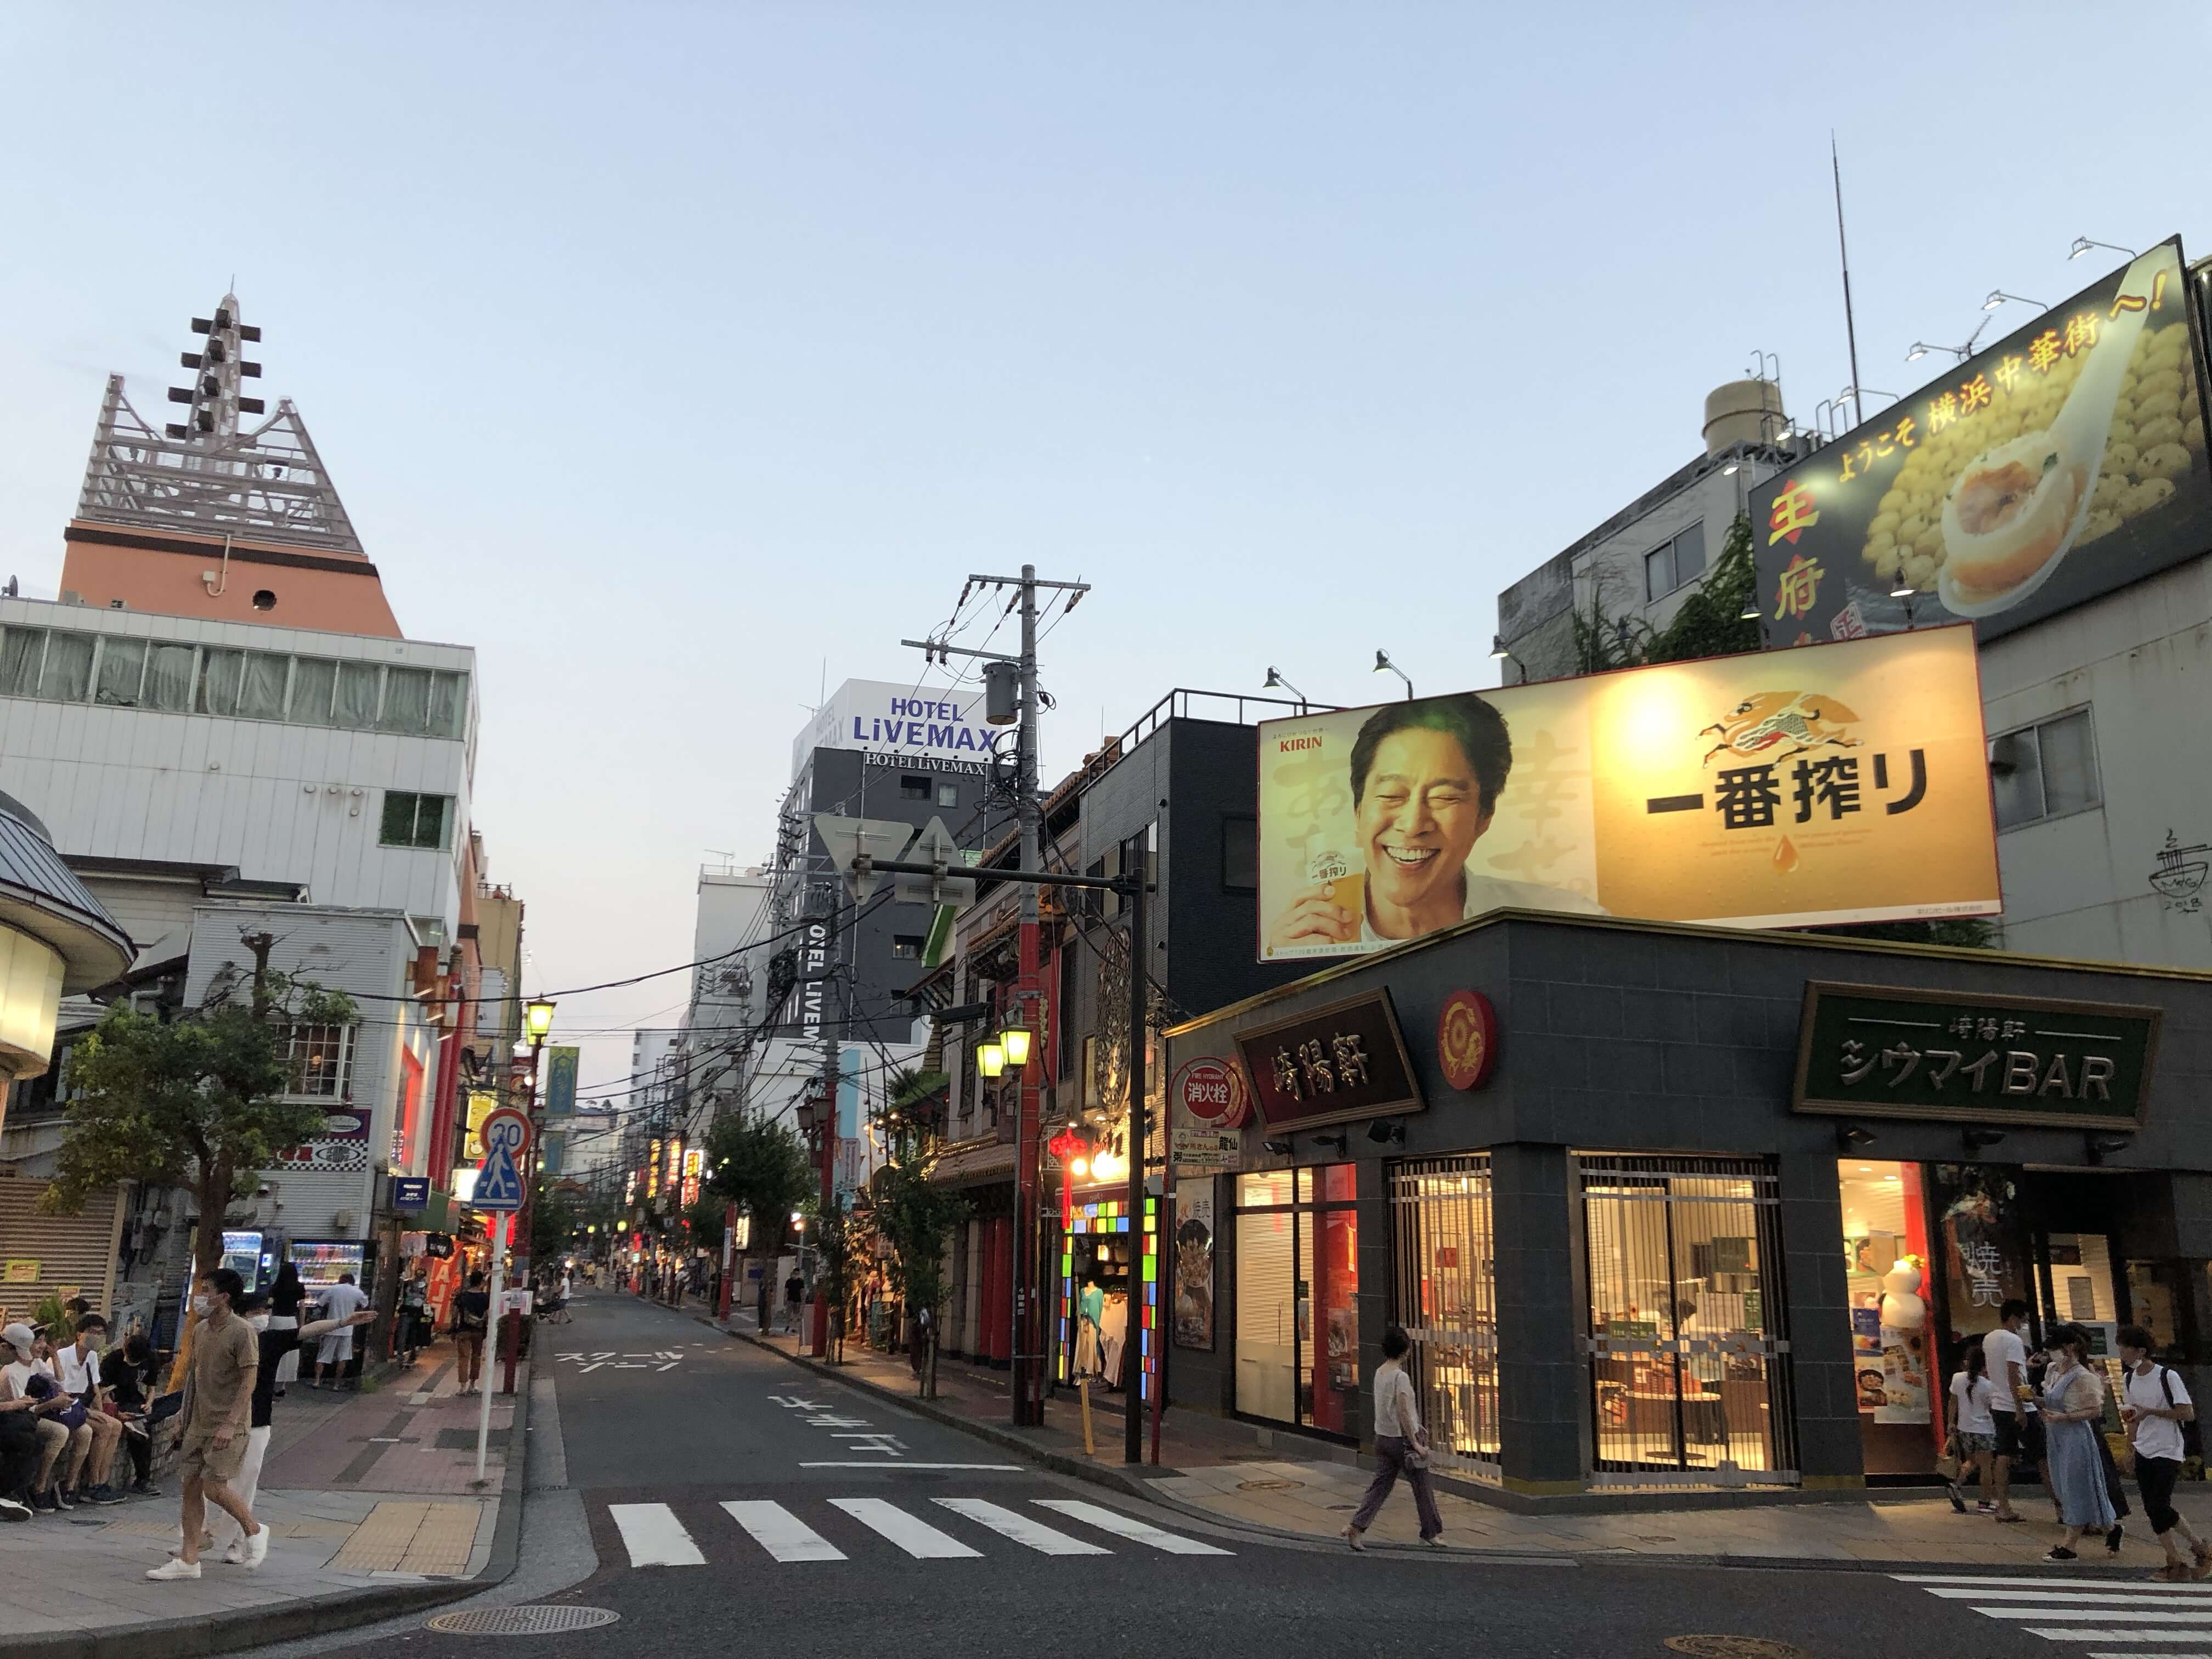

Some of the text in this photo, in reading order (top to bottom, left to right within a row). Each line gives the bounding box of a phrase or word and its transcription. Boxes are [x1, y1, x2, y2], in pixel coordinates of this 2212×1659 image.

[1839, 415, 1916, 483] ようこそ
[1768, 483, 1826, 646] 王府
[891, 697, 964, 722] HOTEL
[854, 716, 997, 753] LiVEMAX
[1280, 736, 1323, 753] KIRIN
[865, 752, 986, 776] HOTEL LiVEMAX
[1647, 749, 1928, 830] 一番搾り
[1312, 866, 1347, 879] 一番搾り
[1948, 1014, 2027, 1041] 崎陽軒
[1840, 1040, 2115, 1101] シウマイBAR
[1188, 1082, 1228, 1104] 消火栓
[1218, 1136, 1238, 1152] 龍仙
[1962, 1241, 2005, 1308] 焼売
[554, 1351, 684, 1362] スクール
